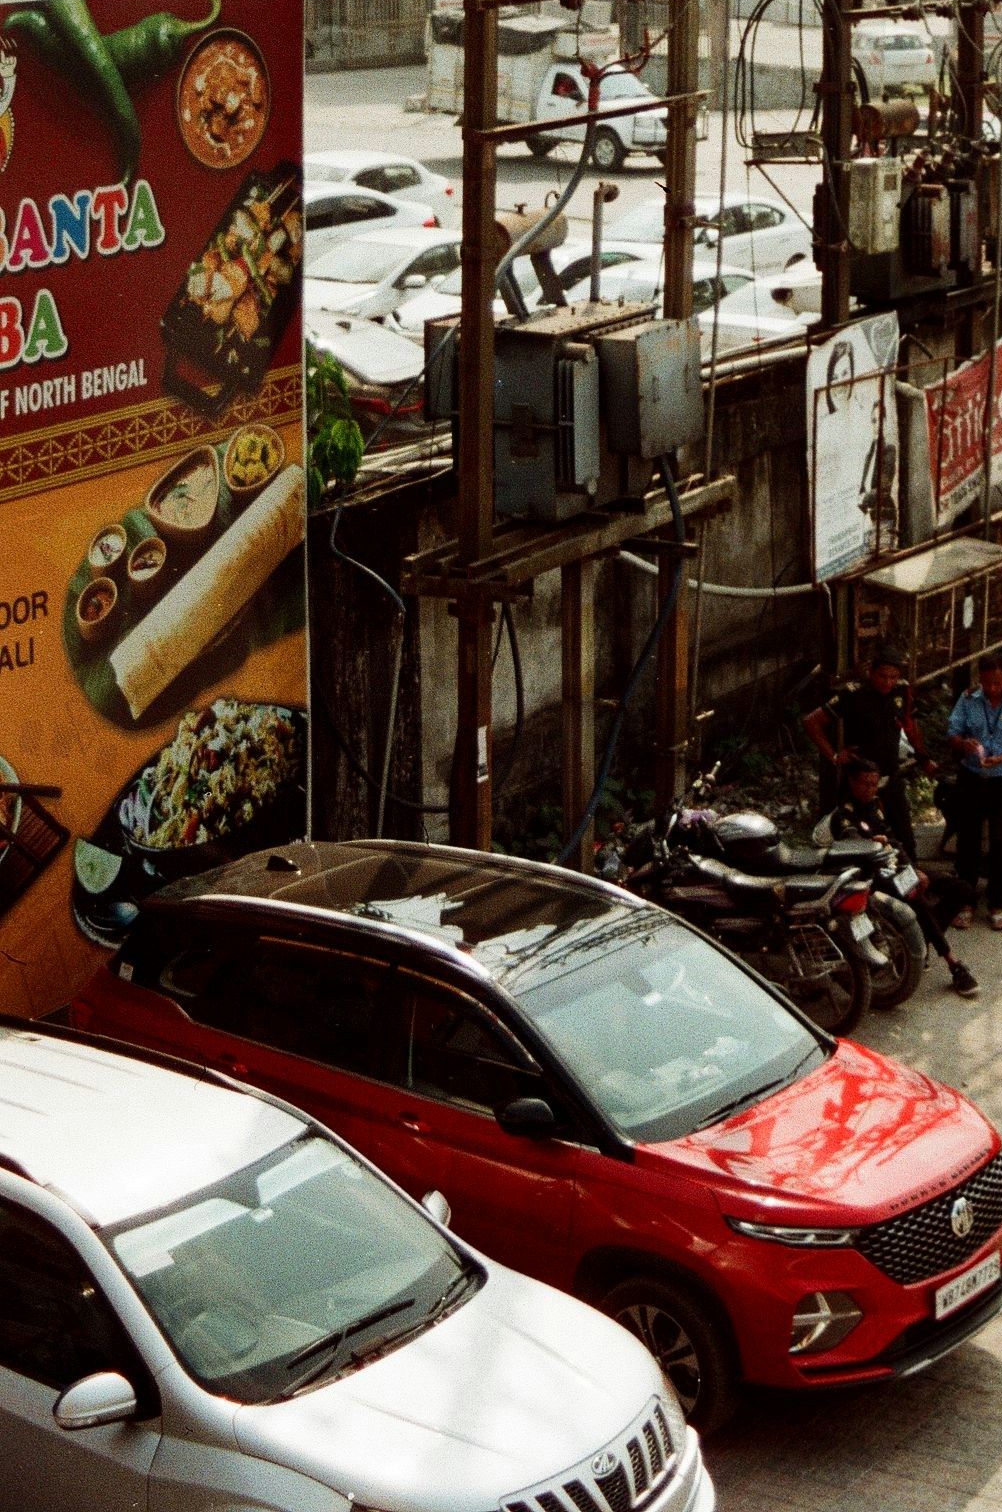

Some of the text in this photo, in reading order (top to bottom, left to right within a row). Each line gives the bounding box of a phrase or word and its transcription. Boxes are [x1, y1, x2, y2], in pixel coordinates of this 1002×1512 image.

[0, 179, 165, 273] ANTA
[14, 375, 76, 415] NORTH
[81, 359, 147, 400] BENGAL
